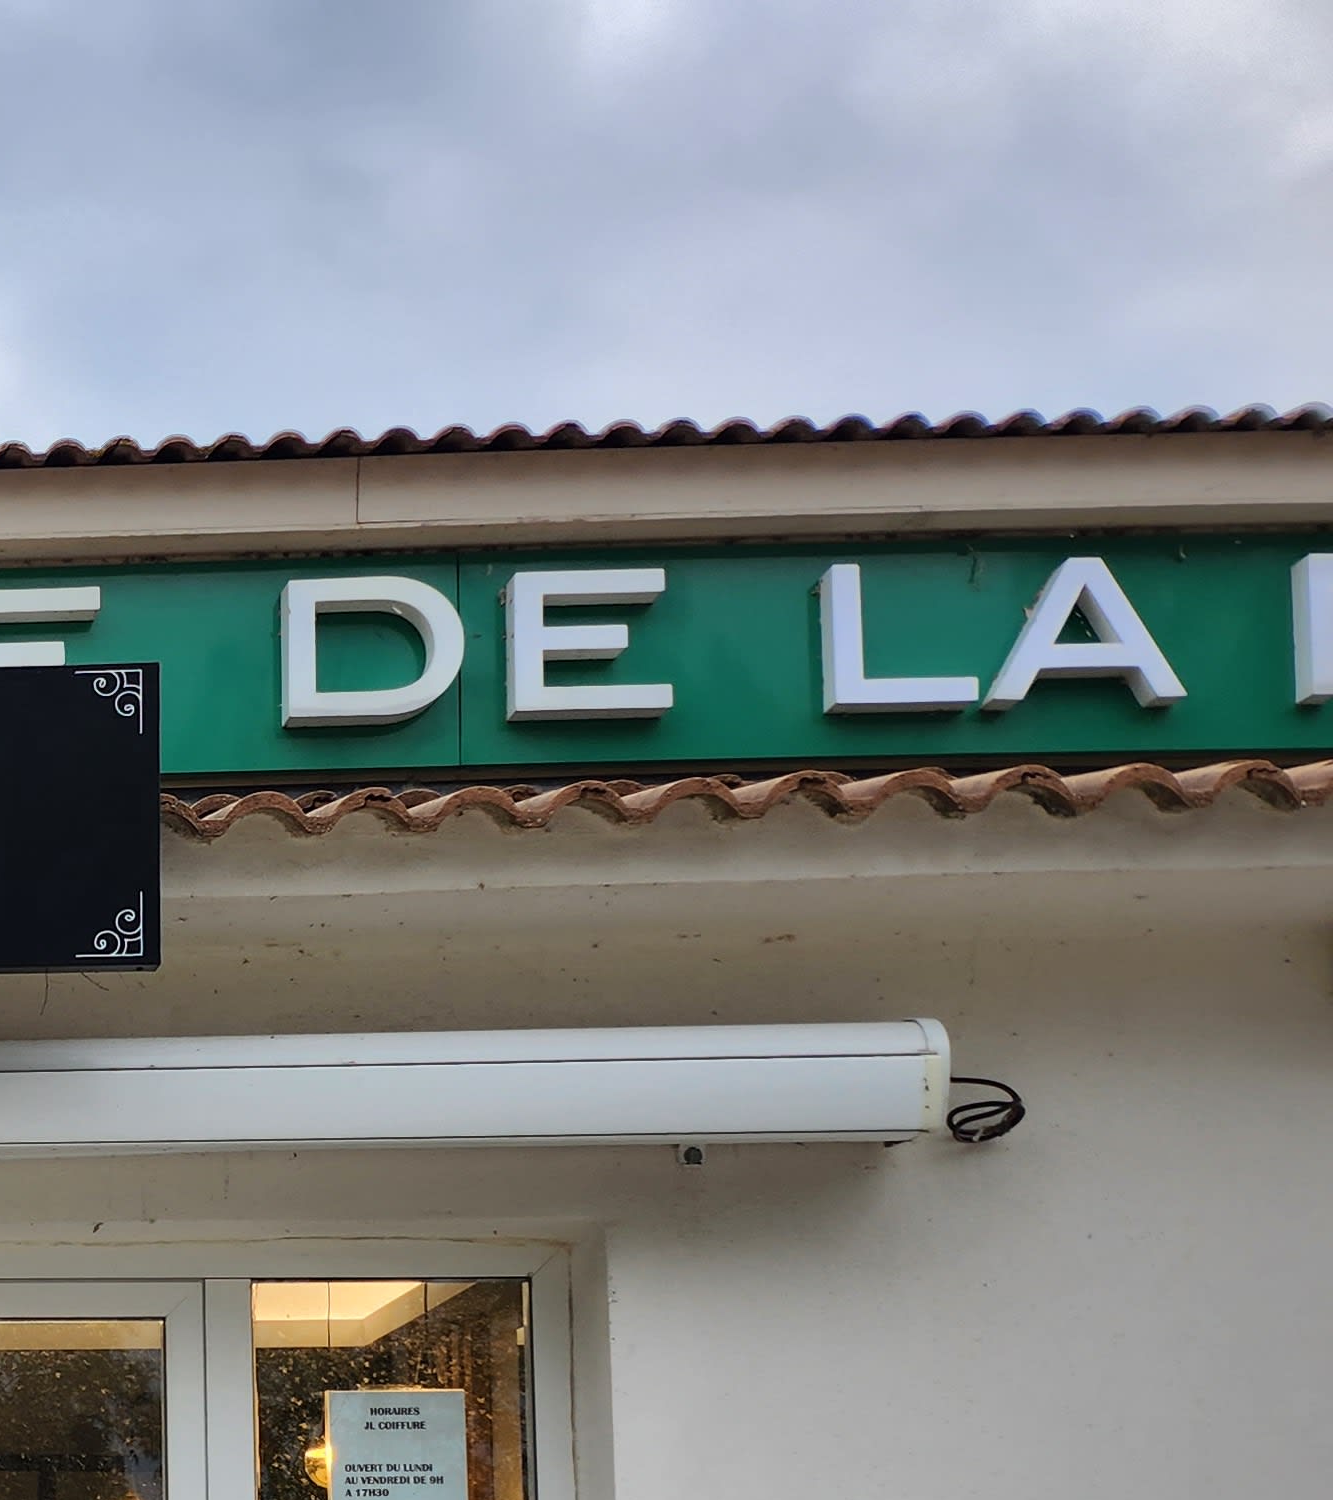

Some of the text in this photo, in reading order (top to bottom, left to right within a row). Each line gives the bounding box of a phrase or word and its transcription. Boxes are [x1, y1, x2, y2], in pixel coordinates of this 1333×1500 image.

[279, 567, 674, 729] DE
[813, 556, 1188, 715] LA
[370, 1407, 420, 1416] HORAIRES
[364, 1421, 427, 1430] JL COIFFURE
[345, 1464, 433, 1472] OUVERT DU LUNDI
[345, 1476, 444, 1485] AU VENDREDI DE 9H
[345, 1489, 389, 1497] A 17H30
